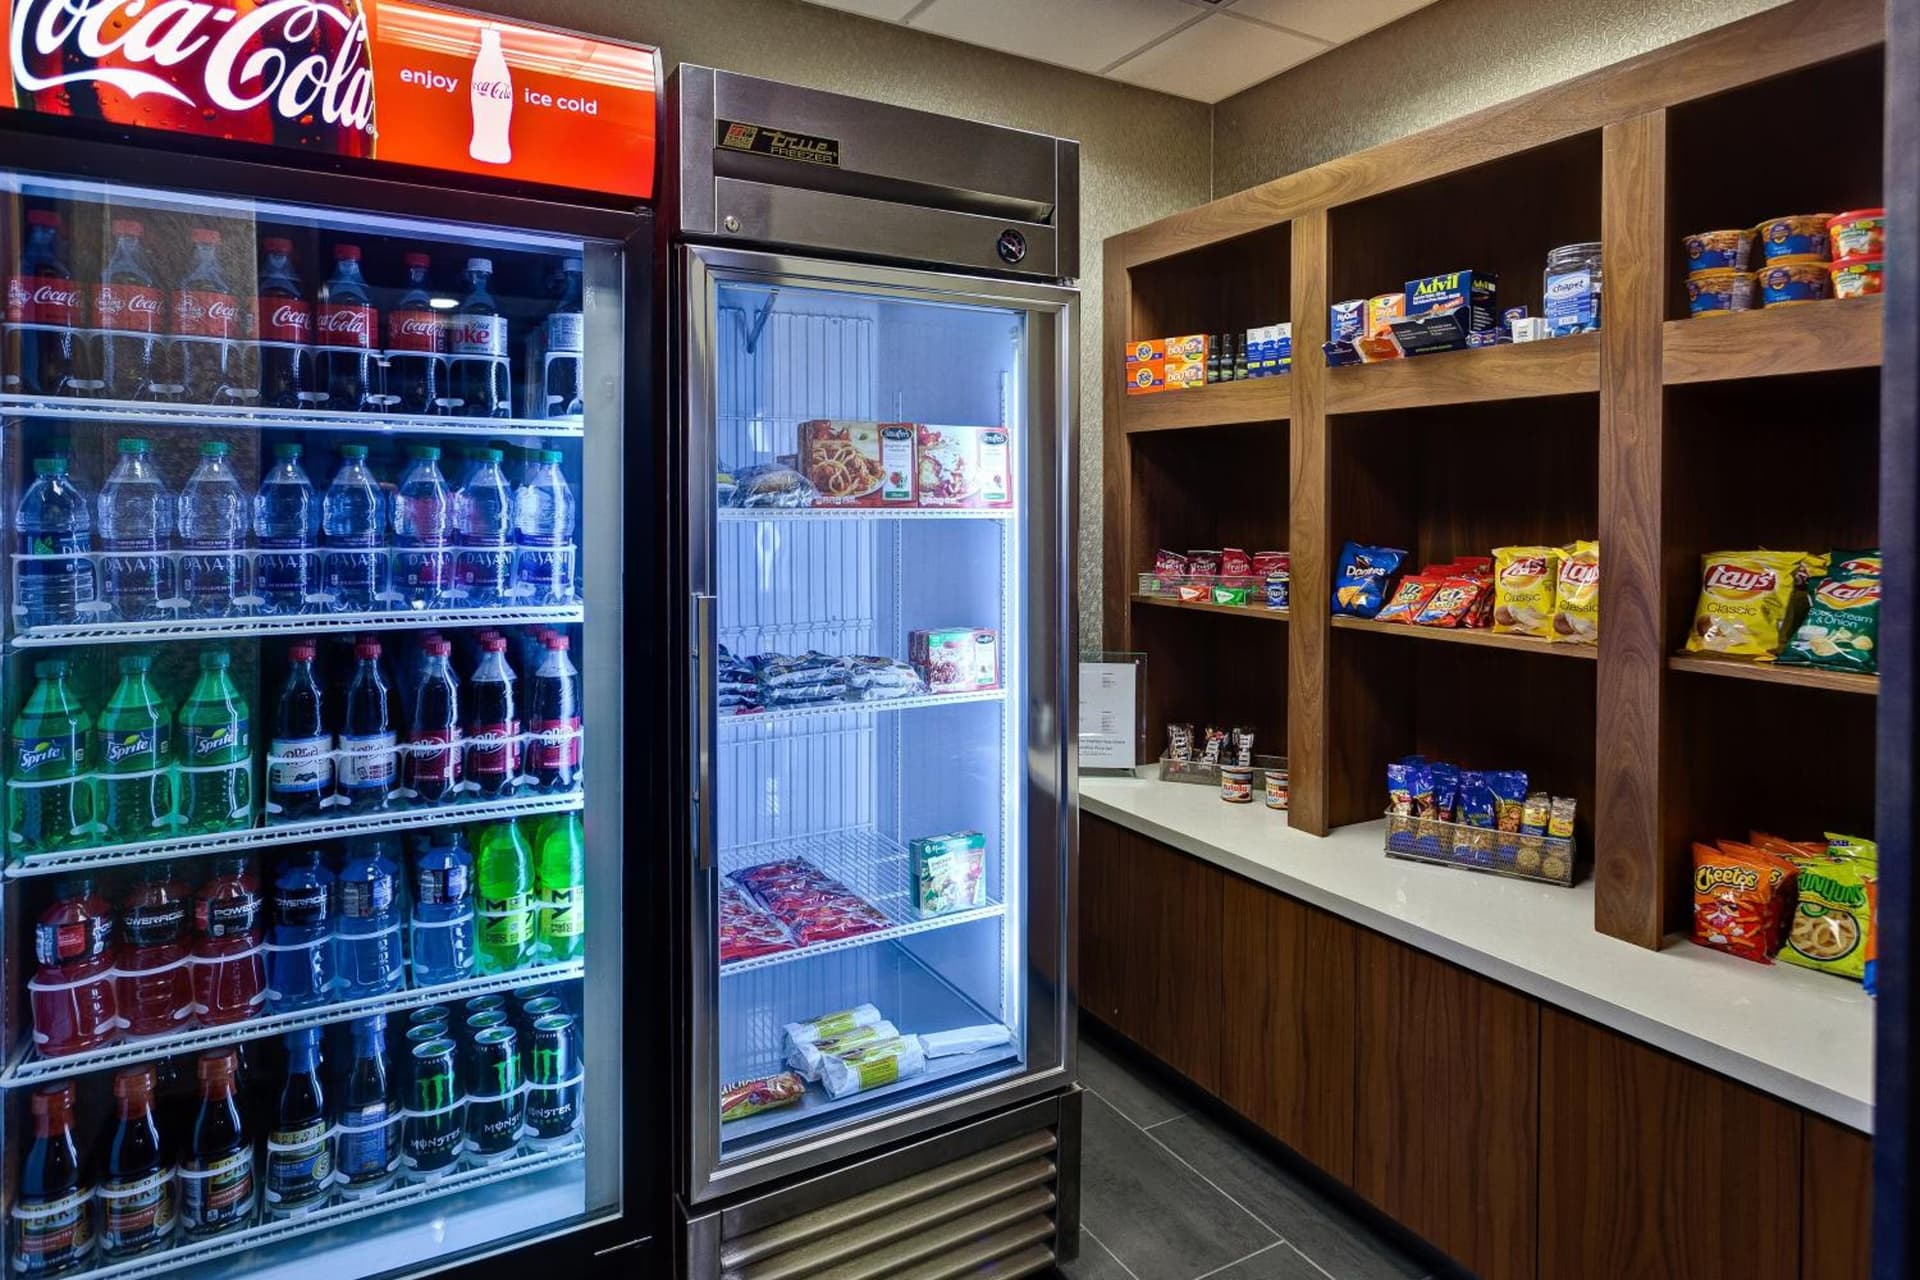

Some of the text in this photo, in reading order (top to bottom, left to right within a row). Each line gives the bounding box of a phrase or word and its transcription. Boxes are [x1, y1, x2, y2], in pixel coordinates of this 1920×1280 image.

[400, 68, 459, 92] enjoy
[524, 88, 598, 115] ice cold
[1414, 273, 1459, 297] Advil
[1706, 565, 1776, 592] Lay's
[1706, 601, 1758, 617] Classic
[1824, 616, 1858, 628] Onion
[20, 747, 61, 767] Sprite
[109, 739, 150, 760] Sprite
[1695, 865, 1759, 893] Cheetos
